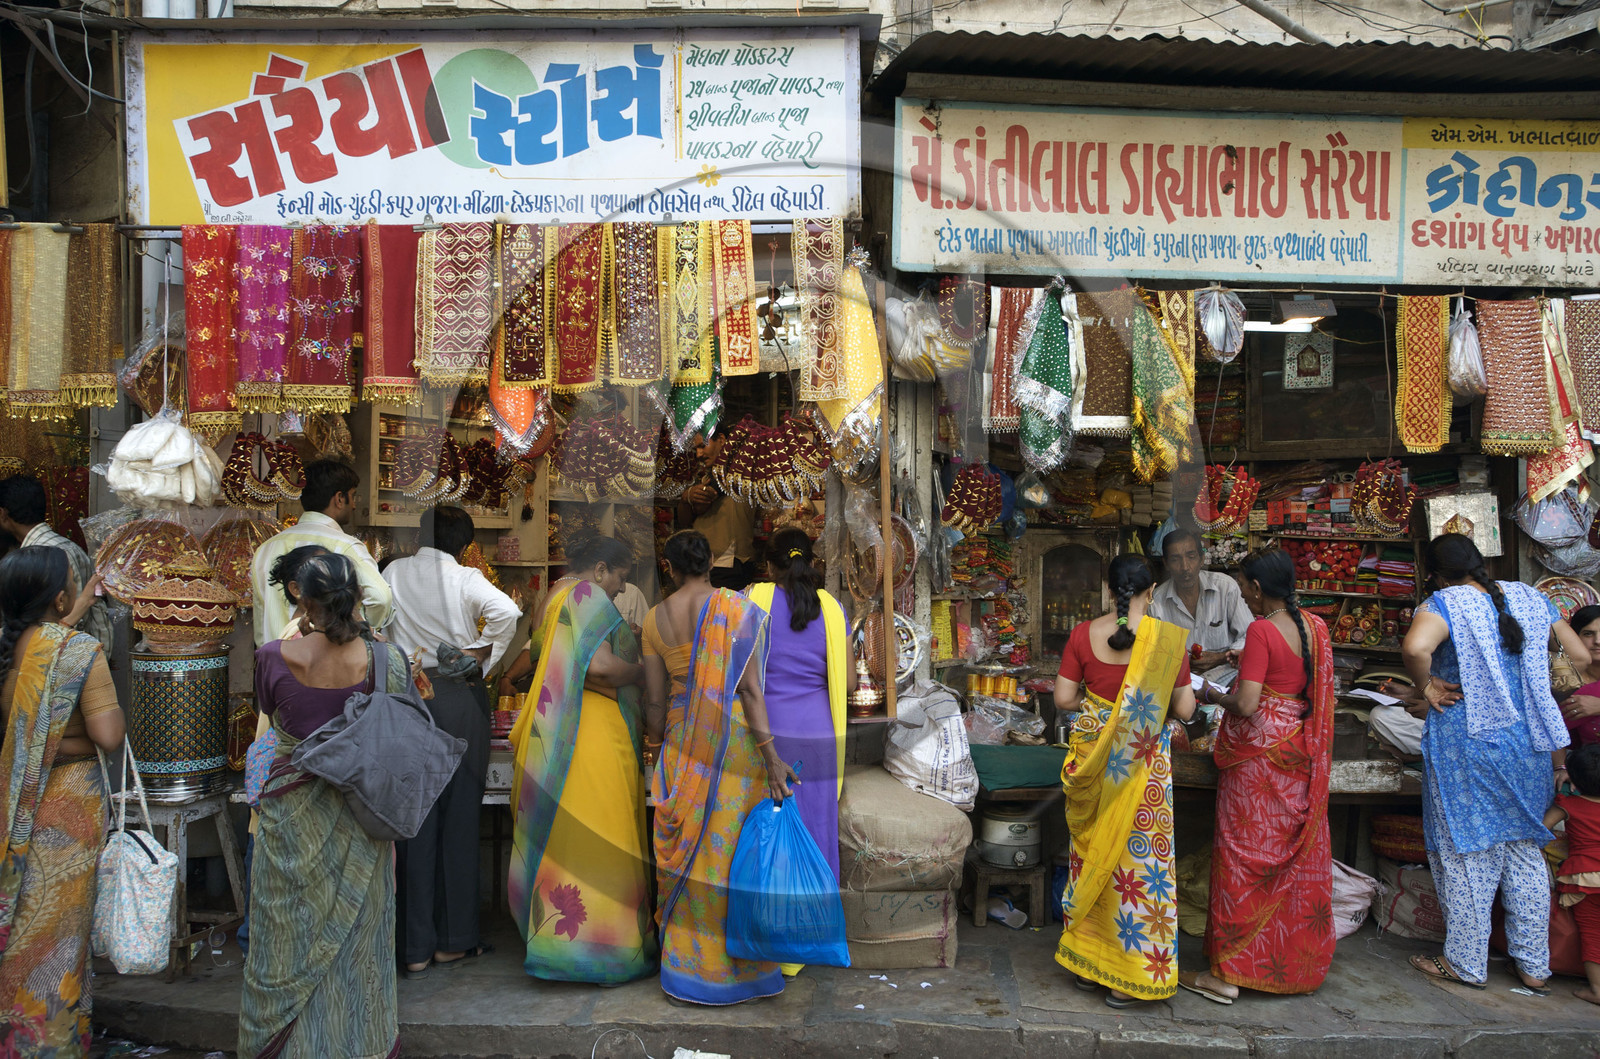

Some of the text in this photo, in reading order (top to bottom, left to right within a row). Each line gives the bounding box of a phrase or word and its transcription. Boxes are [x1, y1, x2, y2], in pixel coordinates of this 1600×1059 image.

[686, 44, 730, 67] મેઘના
[779, 77, 825, 98] પાવડર
[825, 81, 844, 95] તથા
[187, 44, 664, 207] સરૈયા સ્ટોર્સ
[778, 107, 810, 131] પૂજા
[686, 131, 823, 169] પાવડરના વહેપારી
[1300, 130, 1390, 221] સરૈયા
[276, 191, 314, 218] ફેન્સી
[416, 195, 458, 215] ગજરા
[649, 188, 701, 215] હોલસેલ
[703, 196, 730, 212] તથા
[732, 185, 764, 212] રીટેલ
[939, 218, 961, 253] દરેક
[965, 227, 1003, 255] જાતના
[1411, 212, 1486, 250] દશાંગ
[1437, 257, 1479, 274] પવિત્ર
[1566, 260, 1594, 276] માટે
